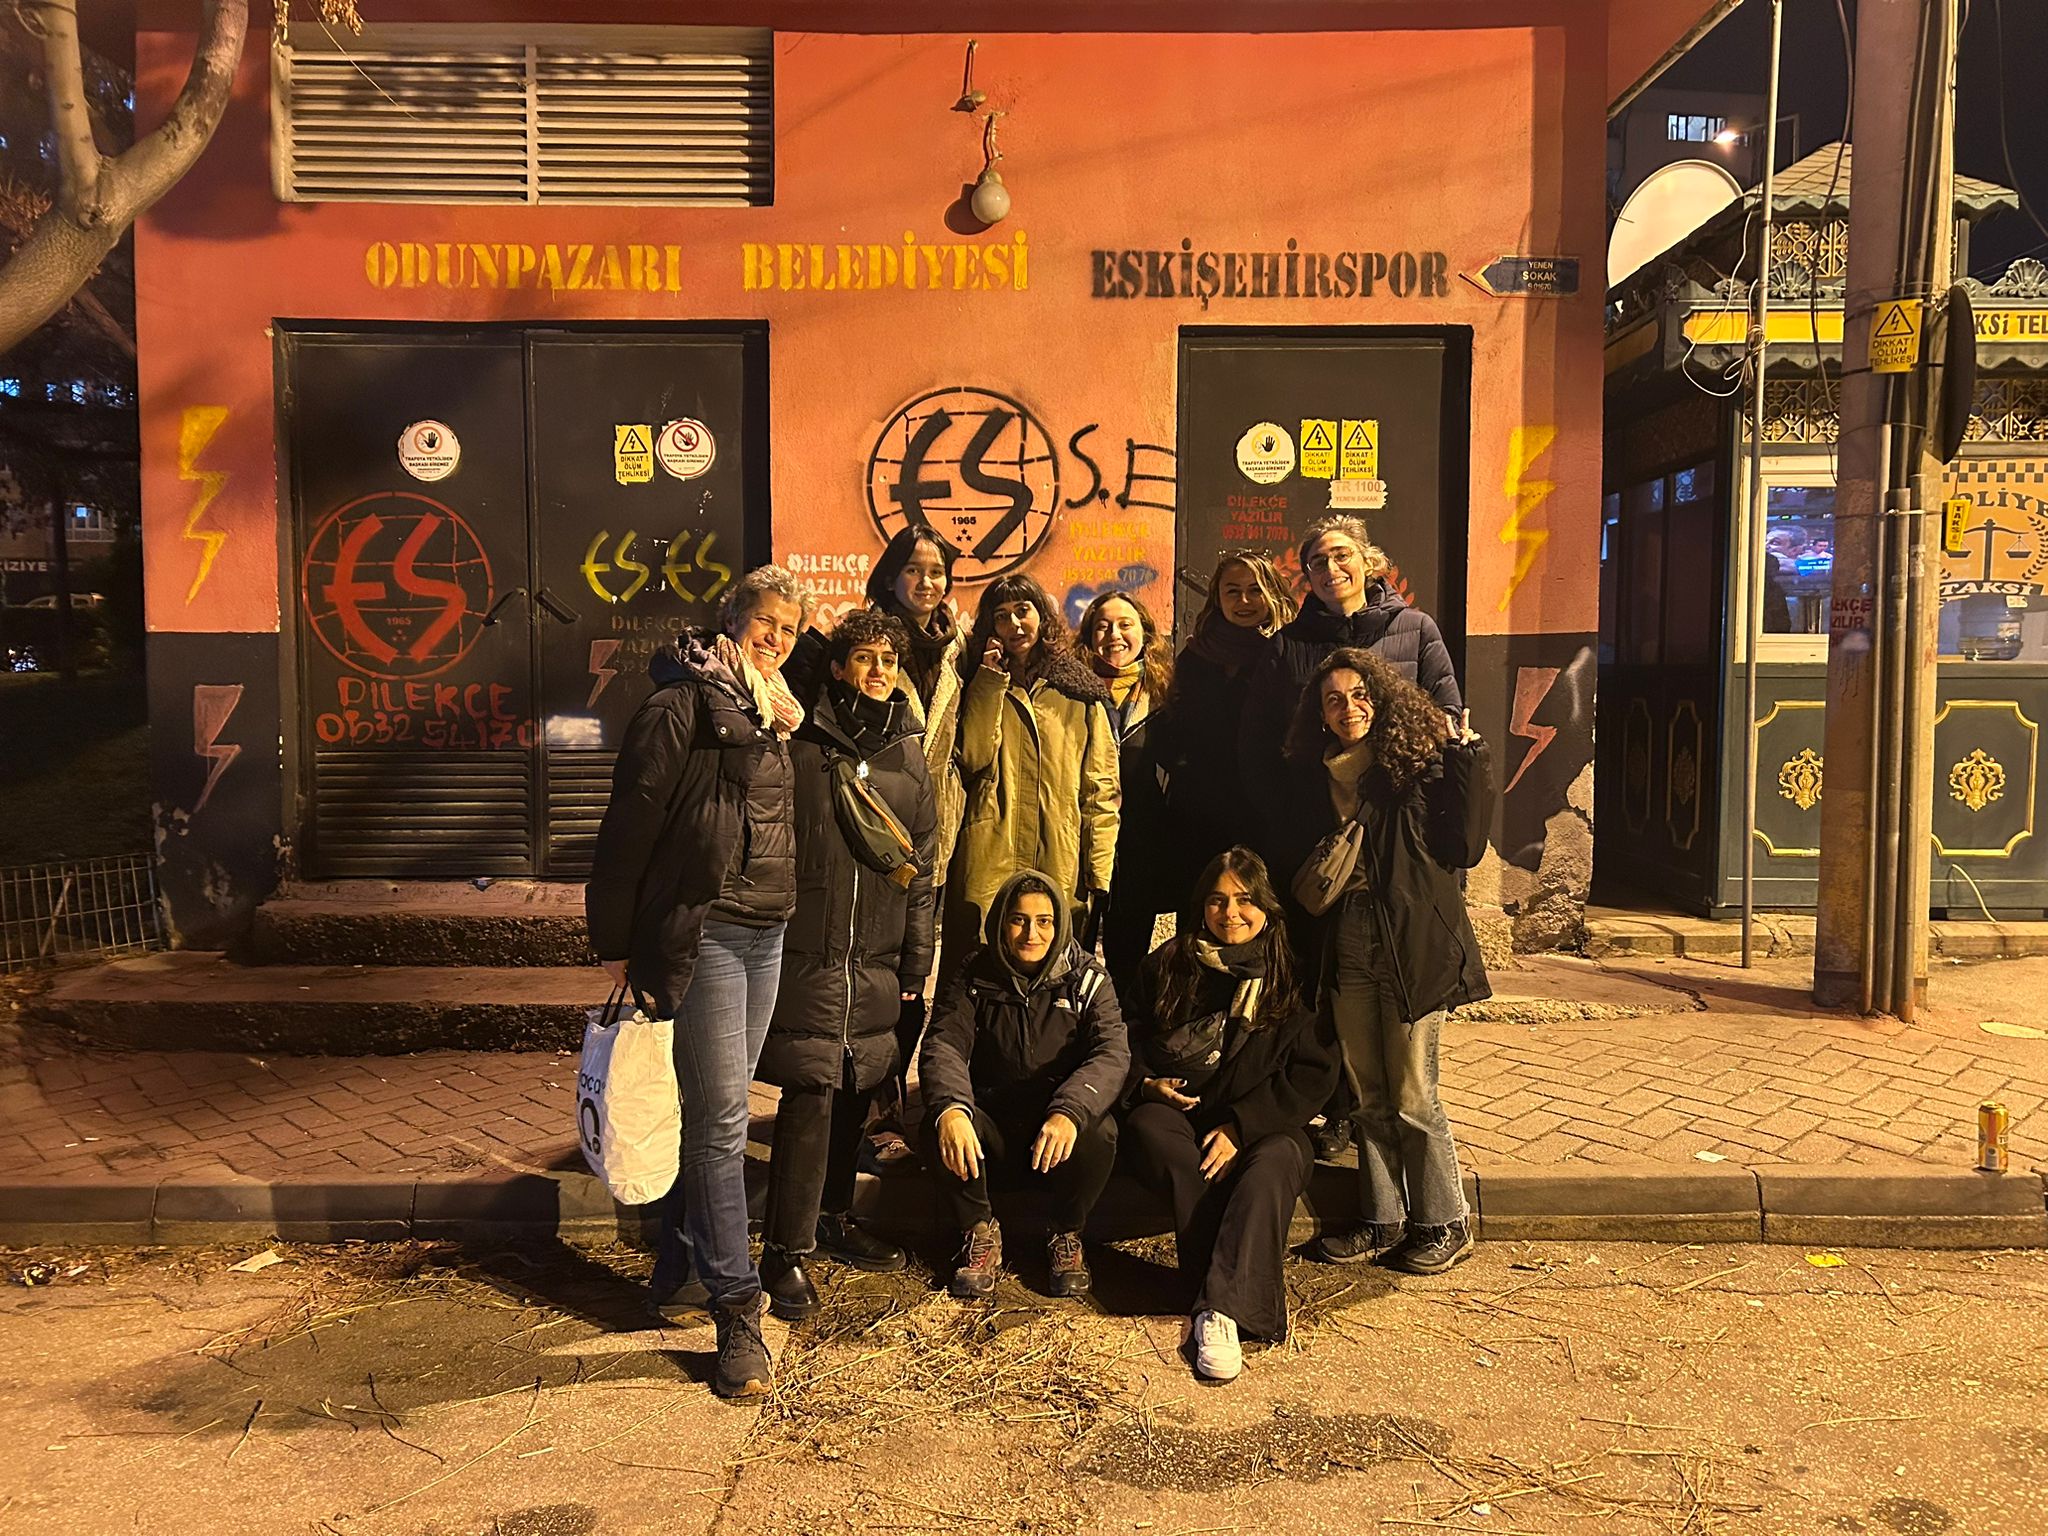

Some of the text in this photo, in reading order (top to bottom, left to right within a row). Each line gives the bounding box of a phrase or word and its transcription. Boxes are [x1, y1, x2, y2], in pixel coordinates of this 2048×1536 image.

[365, 230, 1029, 293] ODUNPAZARI BELEDİYESİ
[1528, 261, 1553, 269] YENEN
[1091, 237, 1451, 311] ESKİŞEHİRSPOR
[1522, 270, 1557, 281] SOKAK
[951, 516, 977, 525] 1965
